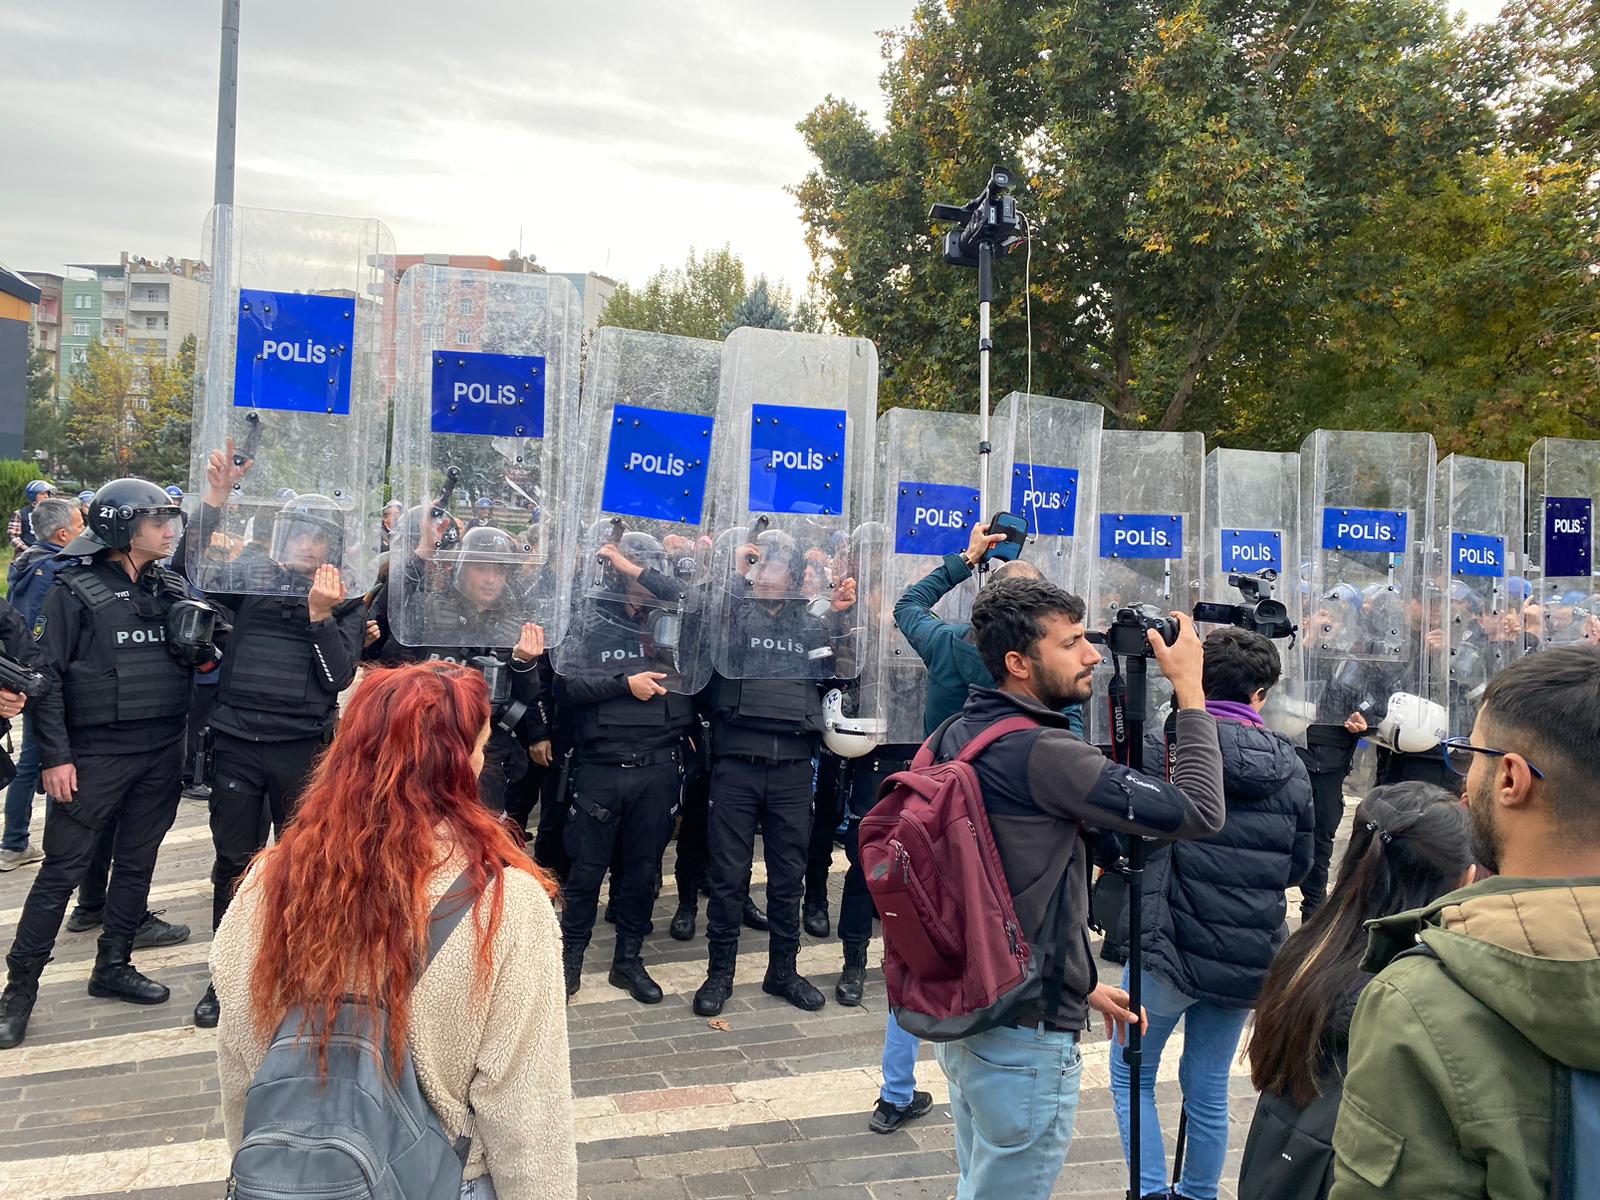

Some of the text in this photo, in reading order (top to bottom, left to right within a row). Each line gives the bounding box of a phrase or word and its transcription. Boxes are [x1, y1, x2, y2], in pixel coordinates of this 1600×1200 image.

[99, 507, 114, 519] 21
[116, 626, 166, 644] POLİ
[601, 644, 646, 662] POLİ
[1115, 706, 1125, 742] Canon
